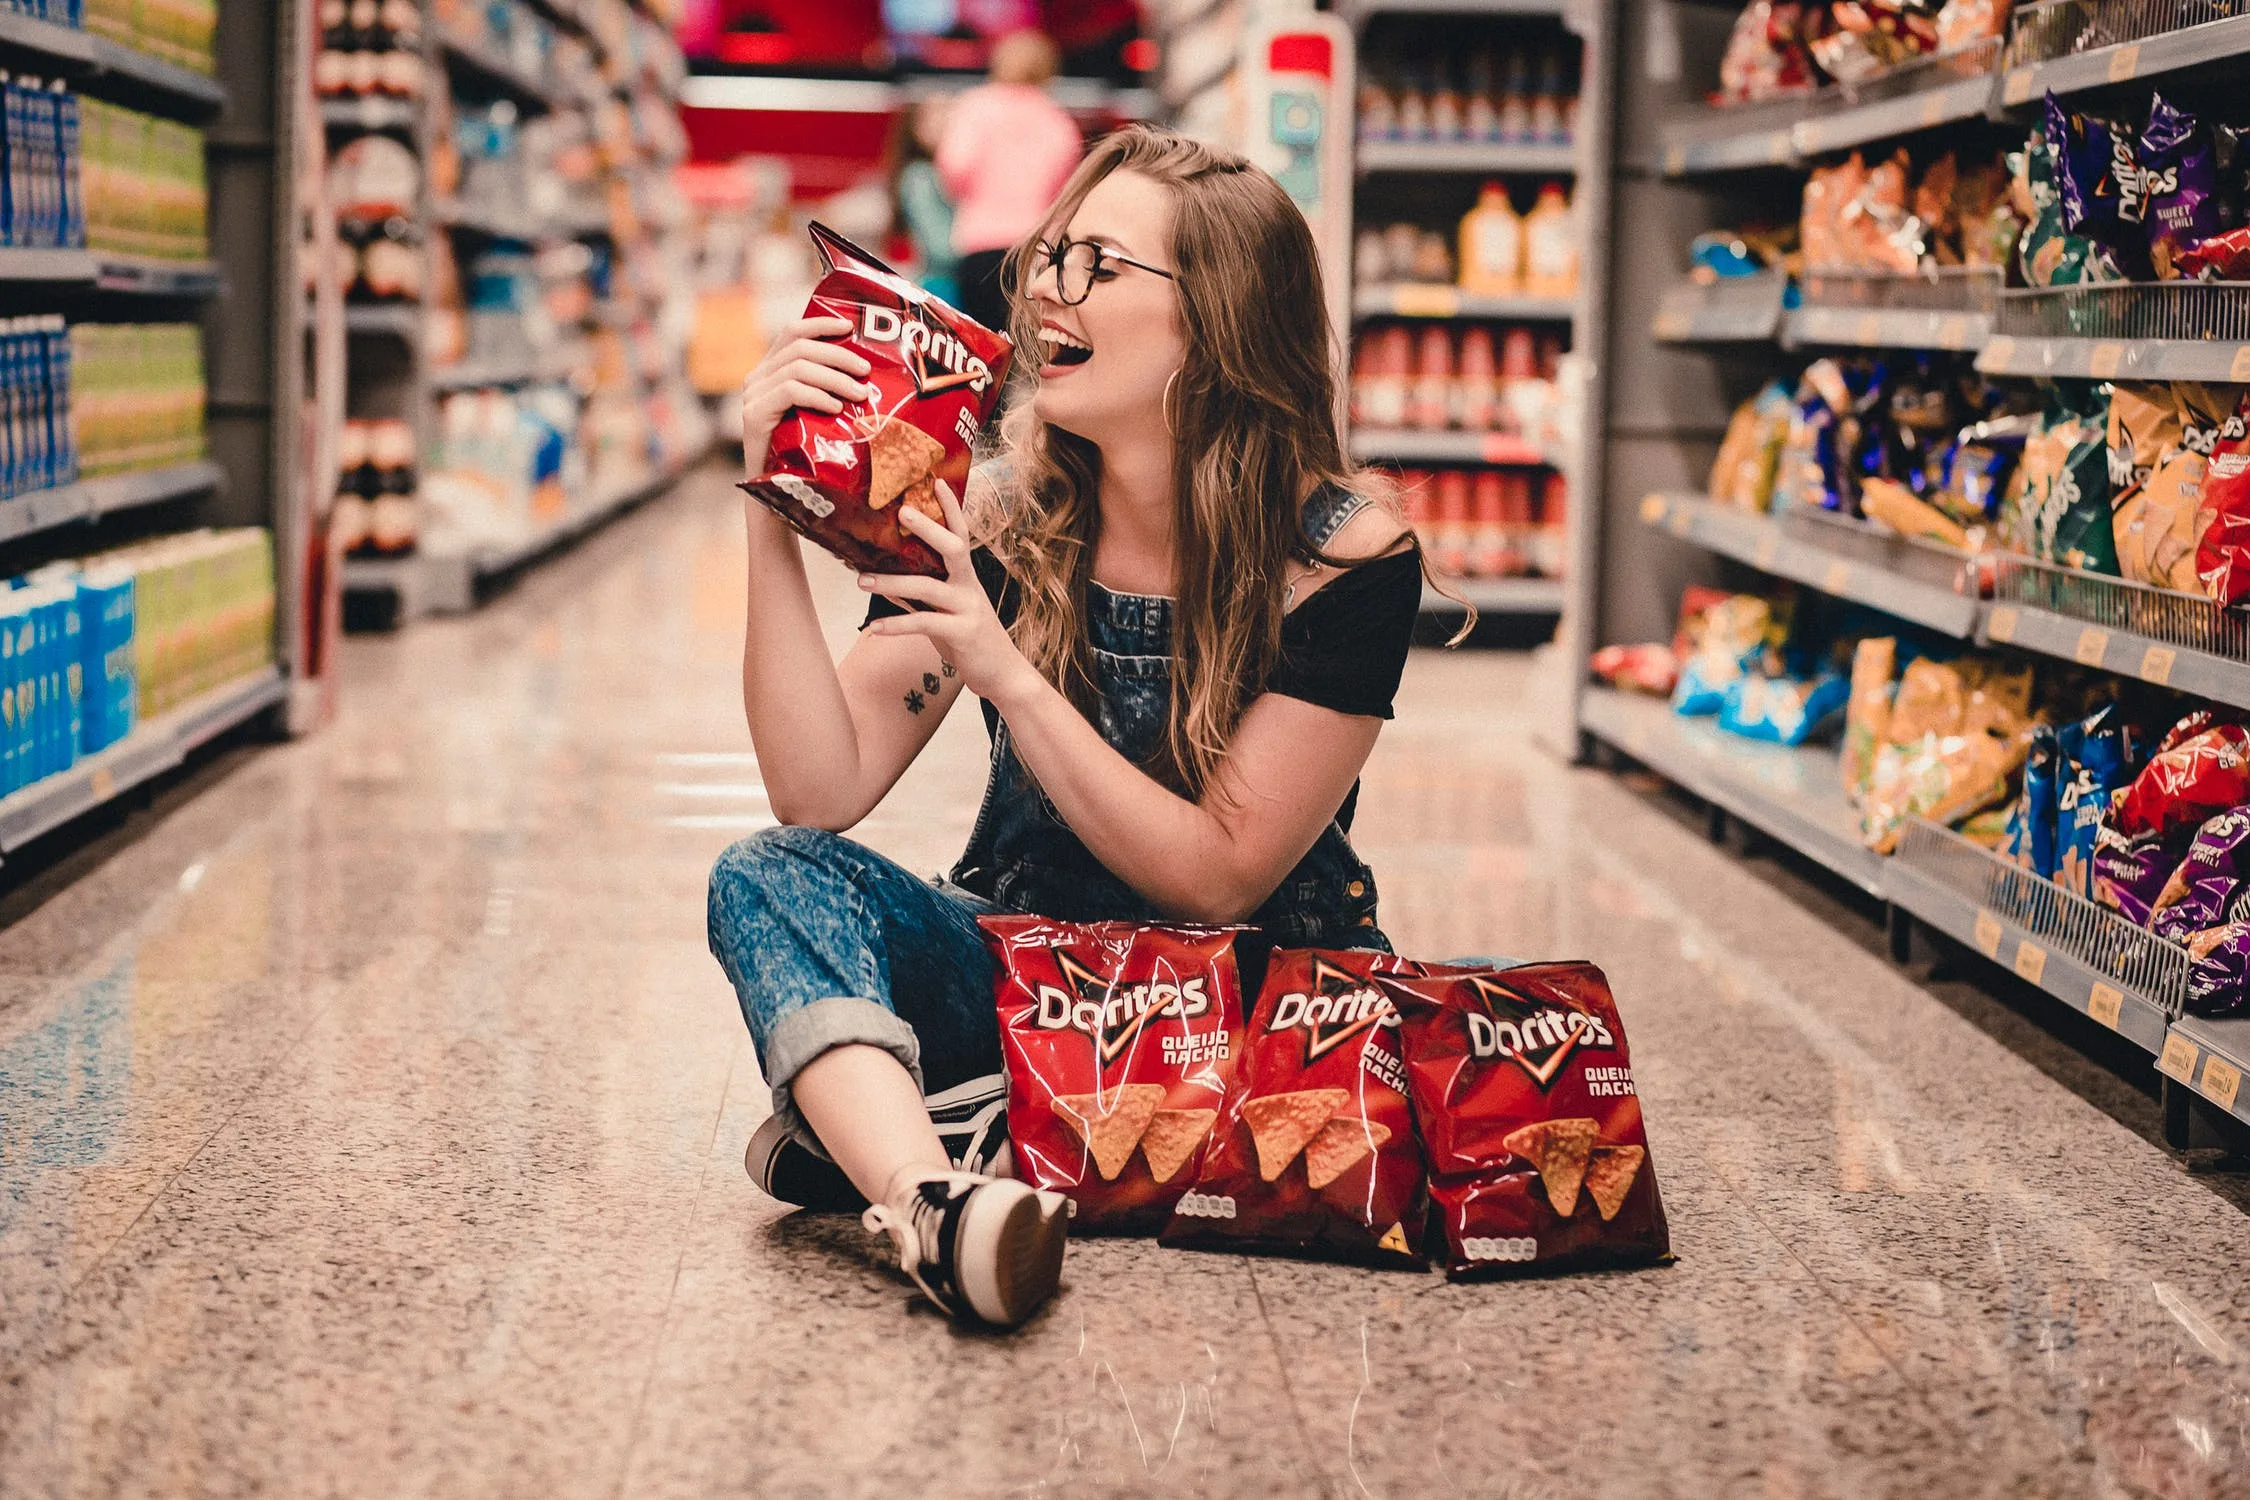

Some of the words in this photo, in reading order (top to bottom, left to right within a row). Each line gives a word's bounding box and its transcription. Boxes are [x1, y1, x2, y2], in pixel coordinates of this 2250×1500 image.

[2168, 216, 2194, 230] CHILI
[1037, 977, 1208, 1030] Doritos
[1161, 1030, 1230, 1051] QUEIJO
[1467, 1009, 1614, 1057] Doritos
[1163, 1045, 1230, 1065] NACHO
[1584, 1066, 1633, 1082] QUEIJ
